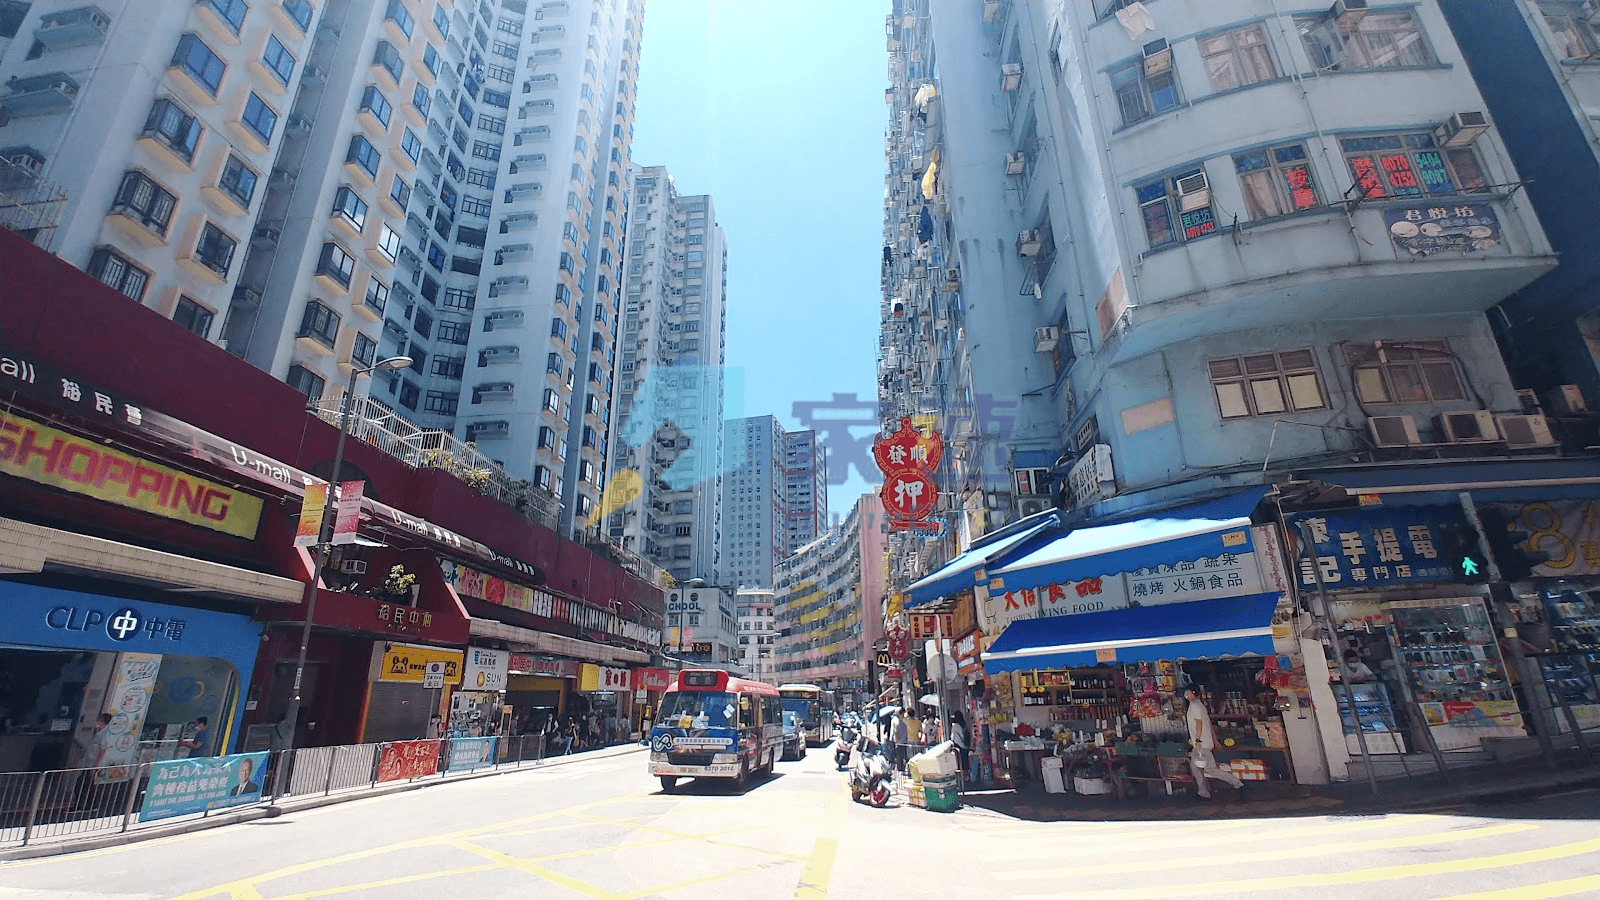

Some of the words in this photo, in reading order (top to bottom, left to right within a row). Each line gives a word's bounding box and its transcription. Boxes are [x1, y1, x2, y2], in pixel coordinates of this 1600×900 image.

[1381, 155, 1409, 172] 6070
[1415, 152, 1442, 169] 5404
[1285, 167, 1317, 209] 按摩
[1389, 171, 1417, 187] 4752
[229, 446, 292, 485] U-mall
[894, 479, 924, 510] 押
[391, 511, 428, 536] U-mall
[1350, 564, 1412, 582] 專門店
[1132, 581, 1164, 597] 燒烤
[1173, 572, 1243, 593] 火鍋食品
[1072, 601, 1105, 613] FOOD
[45, 605, 104, 632] CLP
[486, 672, 502, 684] SUN
